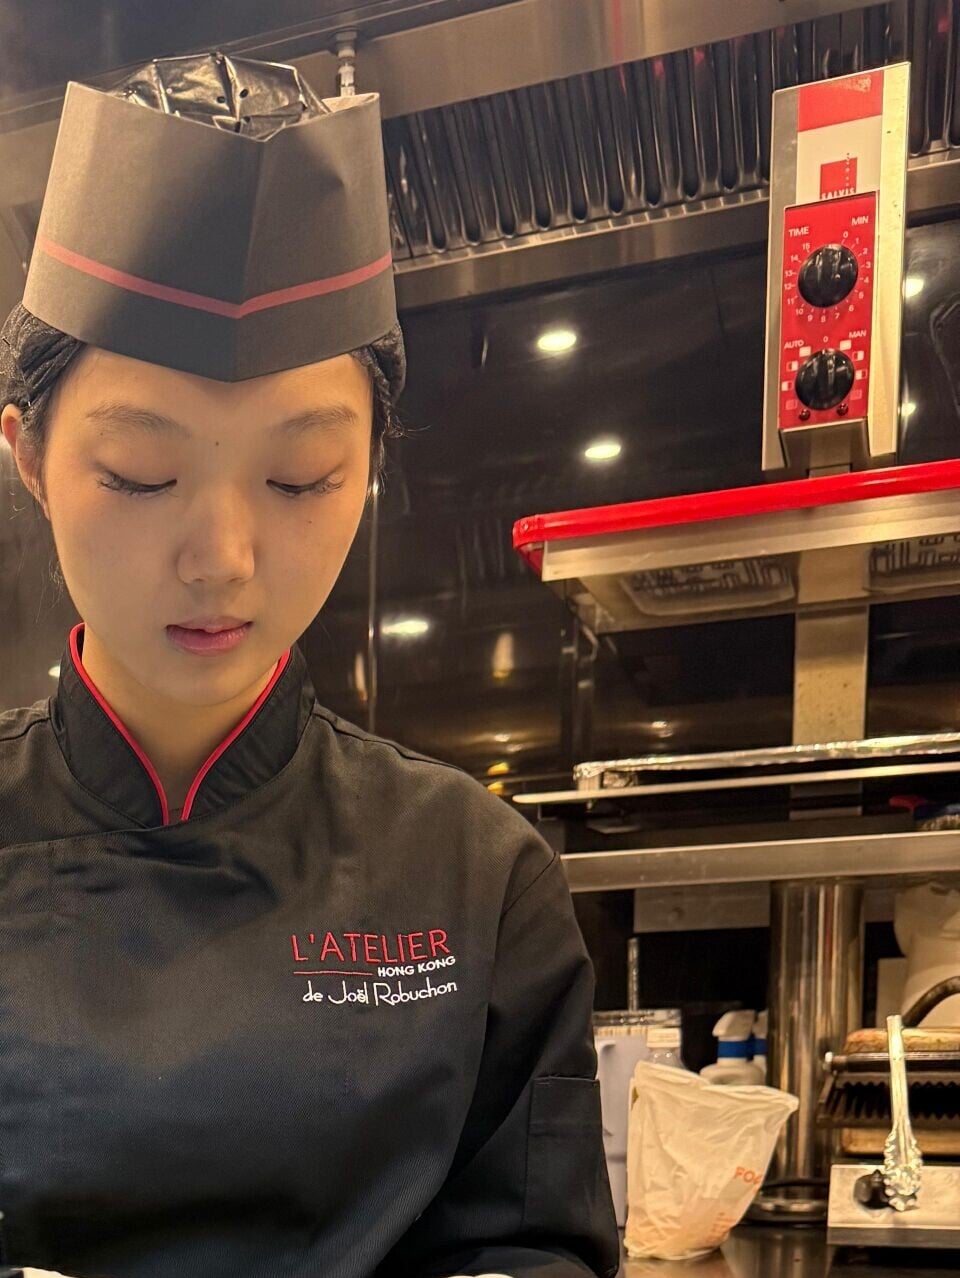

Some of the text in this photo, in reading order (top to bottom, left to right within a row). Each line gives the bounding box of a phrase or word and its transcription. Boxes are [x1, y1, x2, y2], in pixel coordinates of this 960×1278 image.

[851, 216, 869, 226] MIN
[788, 226, 810, 237] TIME
[843, 231, 849, 239] 0
[835, 312, 841, 320] 7
[848, 329, 867, 339] MAN
[783, 338, 805, 349] AUTO
[291, 929, 450, 963] L'ATELIER
[377, 955, 456, 978] HONG KONG
[302, 976, 457, 1007] de Joël Robuchon
